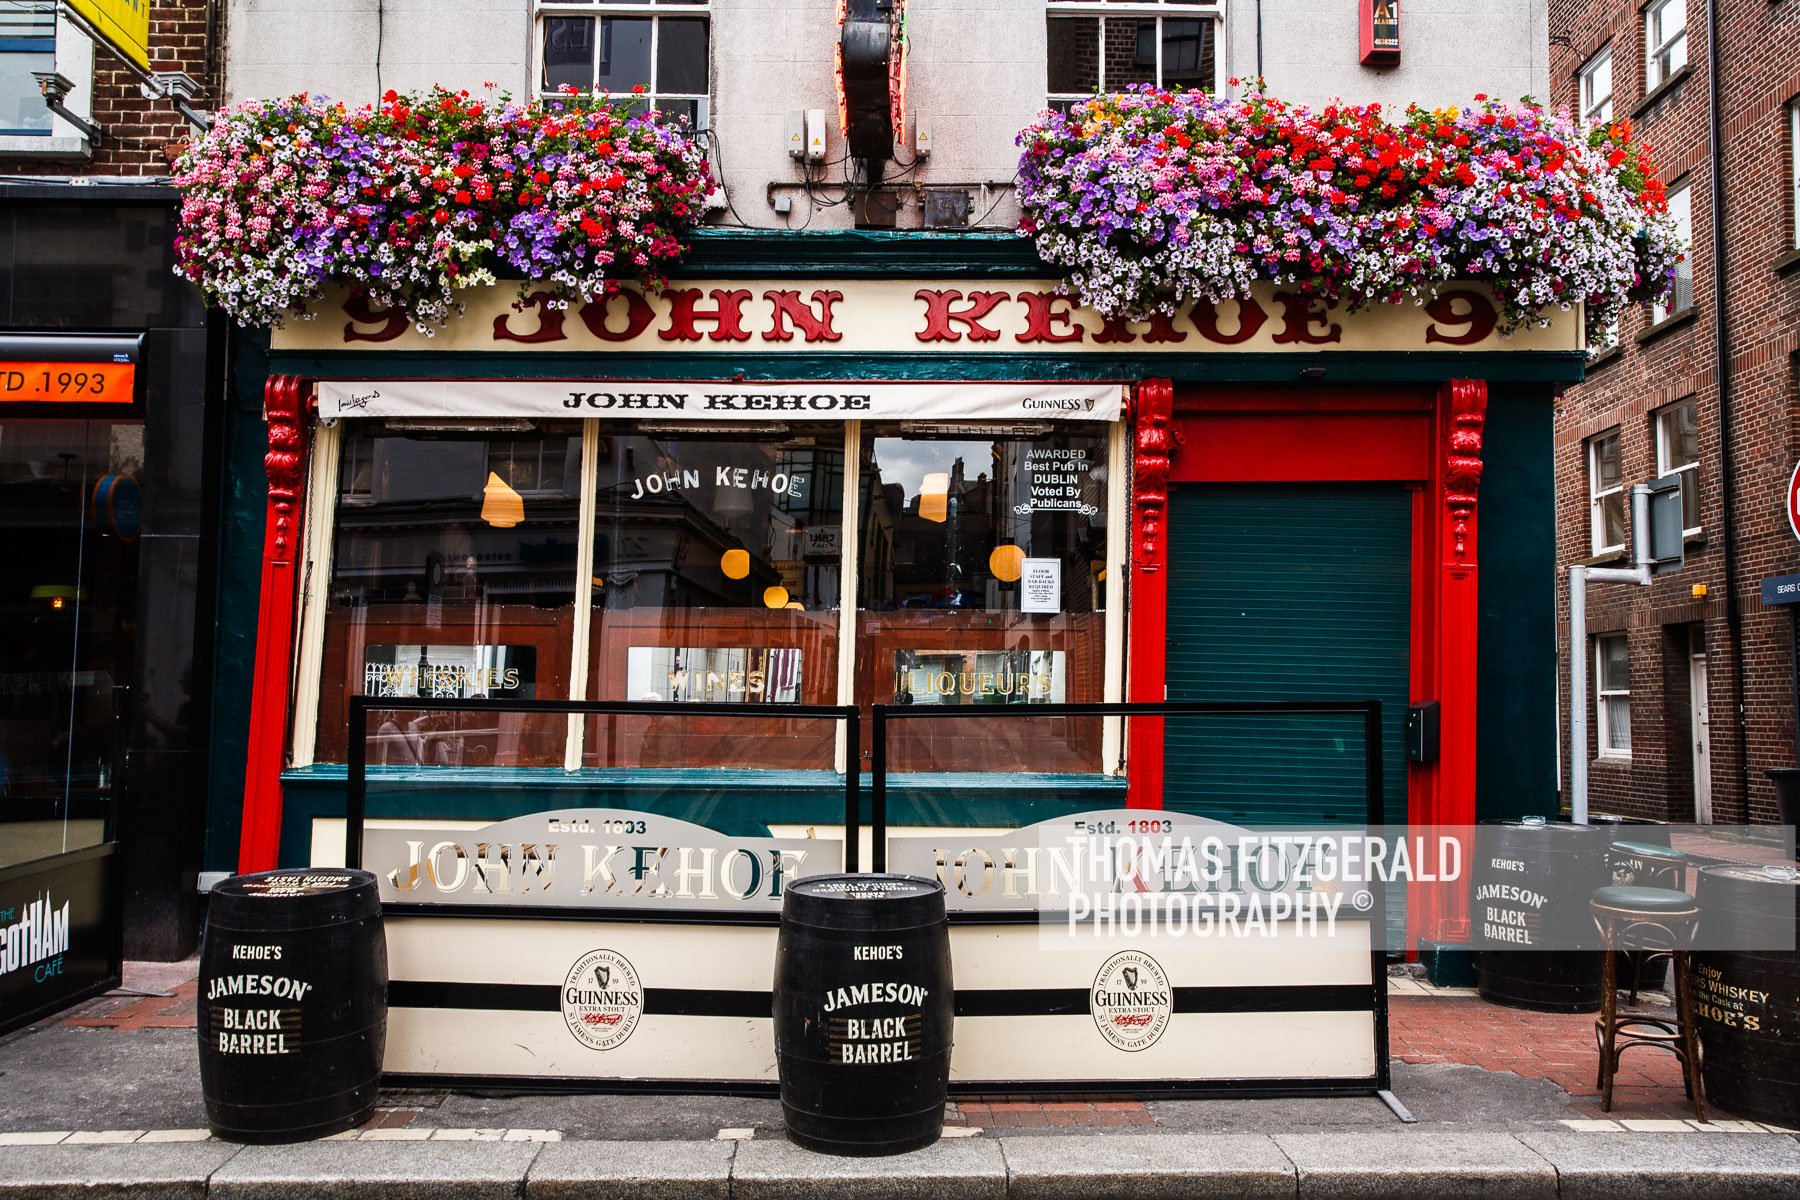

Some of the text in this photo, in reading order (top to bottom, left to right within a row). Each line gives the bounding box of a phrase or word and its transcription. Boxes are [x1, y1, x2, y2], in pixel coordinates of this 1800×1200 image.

[1374, 2, 1398, 18] A1
[493, 288, 844, 343] JOHN
[1425, 290, 1499, 344] 9
[562, 392, 871, 411] JOHN KEHOE
[1022, 397, 1081, 411] GUINNESS
[1026, 449, 1087, 460] AWARDED
[1024, 461, 1089, 472] Best Pub In
[631, 466, 805, 500] JOHN KEHOE
[1034, 474, 1079, 485] DUBLIN
[1031, 486, 1082, 499] Voted By
[1030, 498, 1082, 508] Publicans
[1777, 583, 1796, 594] SEARS
[384, 667, 520, 690] WHISKIES
[668, 669, 766, 693] WINES
[907, 671, 1052, 696] LIQUEURS
[548, 818, 647, 835] Estd. 1803
[1074, 820, 1173, 834] Estd. 1803
[386, 839, 809, 900] JOHN KEHOE
[1491, 857, 1525, 872] KEHOE'S
[1487, 906, 1526, 927] BLACK
[1484, 922, 1533, 945] BARREL
[232, 944, 283, 960] KEHOE'S
[853, 945, 904, 961] KEHOE'S
[571, 955, 636, 987] TRADITIONALLY BREWED
[1098, 954, 1164, 987] TRADITIONALLY BREWED
[1697, 963, 1722, 982] Enjoy
[566, 987, 639, 1006] GUINNESS
[1095, 990, 1168, 1007] GUINNESS
[1708, 979, 1770, 1004] WHISKEY
[579, 1005, 602, 1013] EXTRA
[1732, 1001, 1744, 1011] at
[224, 1007, 281, 1030] BLACK
[847, 1016, 907, 1040] BLACK
[595, 1039, 616, 1047] GATE
[615, 1014, 636, 1040] DUBLIN
[1127, 1039, 1148, 1048] GATE
[1146, 1014, 1166, 1041] DUBLIN
[219, 1031, 290, 1055] BARREL
[842, 1040, 913, 1064] BARREL
